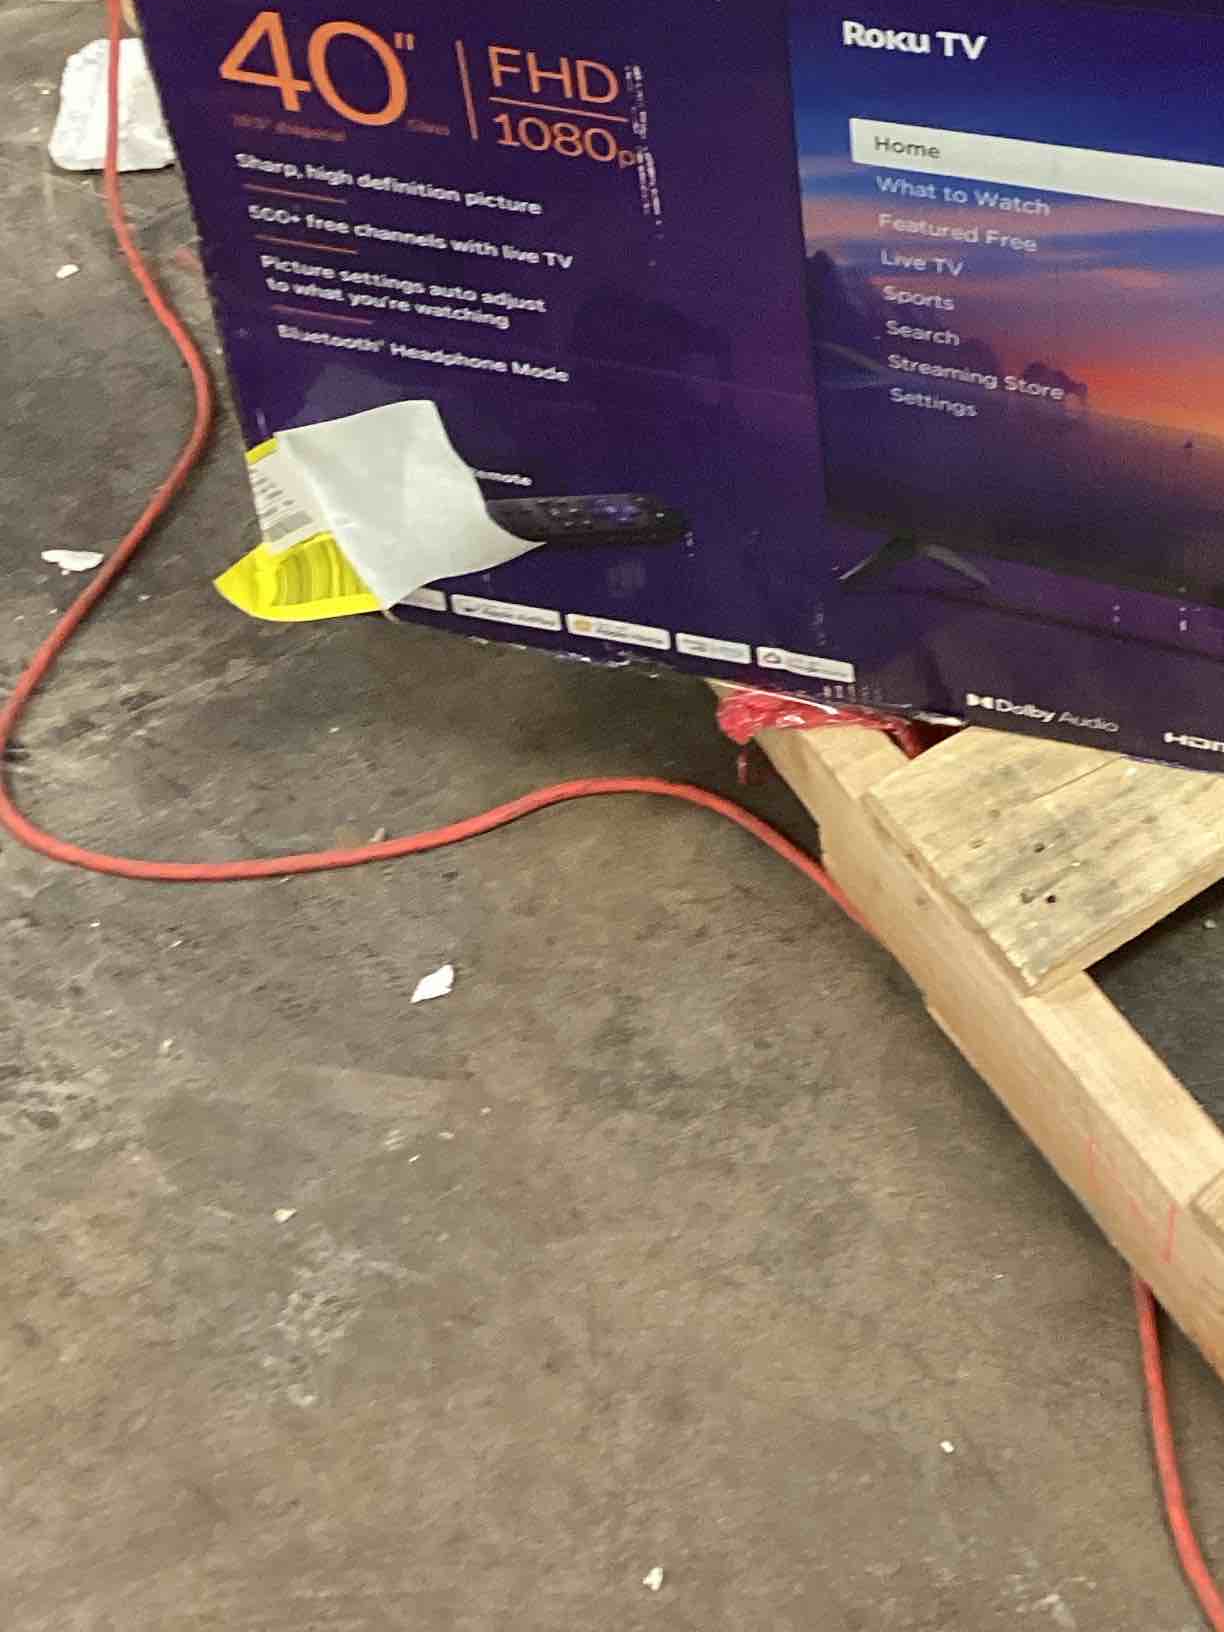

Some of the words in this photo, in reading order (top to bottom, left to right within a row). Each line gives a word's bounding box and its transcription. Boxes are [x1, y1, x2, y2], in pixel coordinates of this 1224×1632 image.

[842, 19, 931, 54] Roku
[935, 30, 988, 60] TV
[487, 44, 620, 105] FHD
[493, 112, 640, 169] 1080p
[873, 135, 941, 160] Home
[235, 152, 304, 180] Sharp,
[304, 162, 354, 186] high
[356, 173, 461, 202] definition
[464, 191, 544, 216] picture
[876, 175, 937, 200] What
[943, 186, 969, 204] to
[974, 188, 1051, 216] Watch
[304, 213, 351, 235] free
[353, 223, 449, 250] channels
[449, 238, 499, 257] with
[501, 244, 541, 265] live
[541, 251, 574, 269] TV
[878, 213, 980, 244] Featured
[985, 229, 1039, 253] Free
[260, 254, 337, 280] Picture
[339, 268, 426, 295] settings
[428, 283, 479, 302] auto
[481, 288, 548, 313] adjust
[881, 249, 928, 271] Live
[933, 256, 965, 277] TV
[266, 277, 291, 293] to
[292, 280, 344, 303] what
[348, 292, 412, 313] you're
[414, 302, 511, 330] watching
[882, 284, 956, 311] Sports
[885, 319, 961, 347] Search
[389, 342, 508, 373] Headphone
[510, 360, 570, 383] Mode
[887, 353, 999, 390] Streaming
[1003, 375, 1066, 401] Store
[889, 386, 979, 418] Settings
[995, 698, 1057, 723] Dolby
[1058, 711, 1120, 734] Audio
